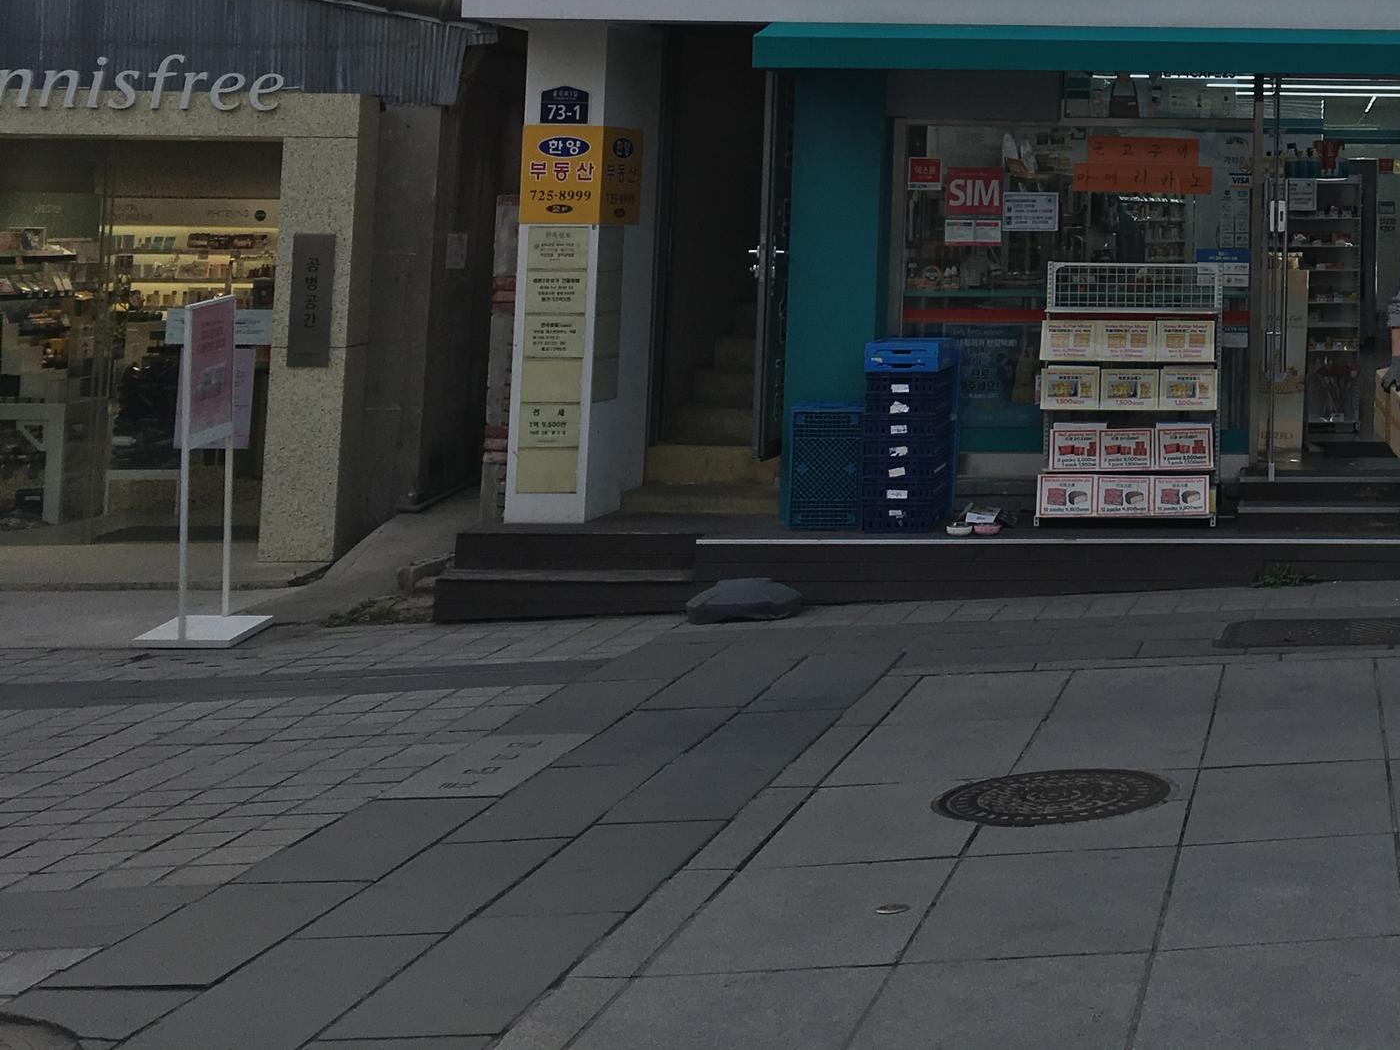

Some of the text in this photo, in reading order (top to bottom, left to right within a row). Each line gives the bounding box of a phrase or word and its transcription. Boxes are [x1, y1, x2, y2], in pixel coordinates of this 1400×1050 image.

[547, 104, 580, 120] 73-1
[549, 140, 581, 155] 한양
[530, 161, 594, 182] 부동산
[949, 179, 1000, 207] SIM
[303, 256, 320, 329] 공병공간
